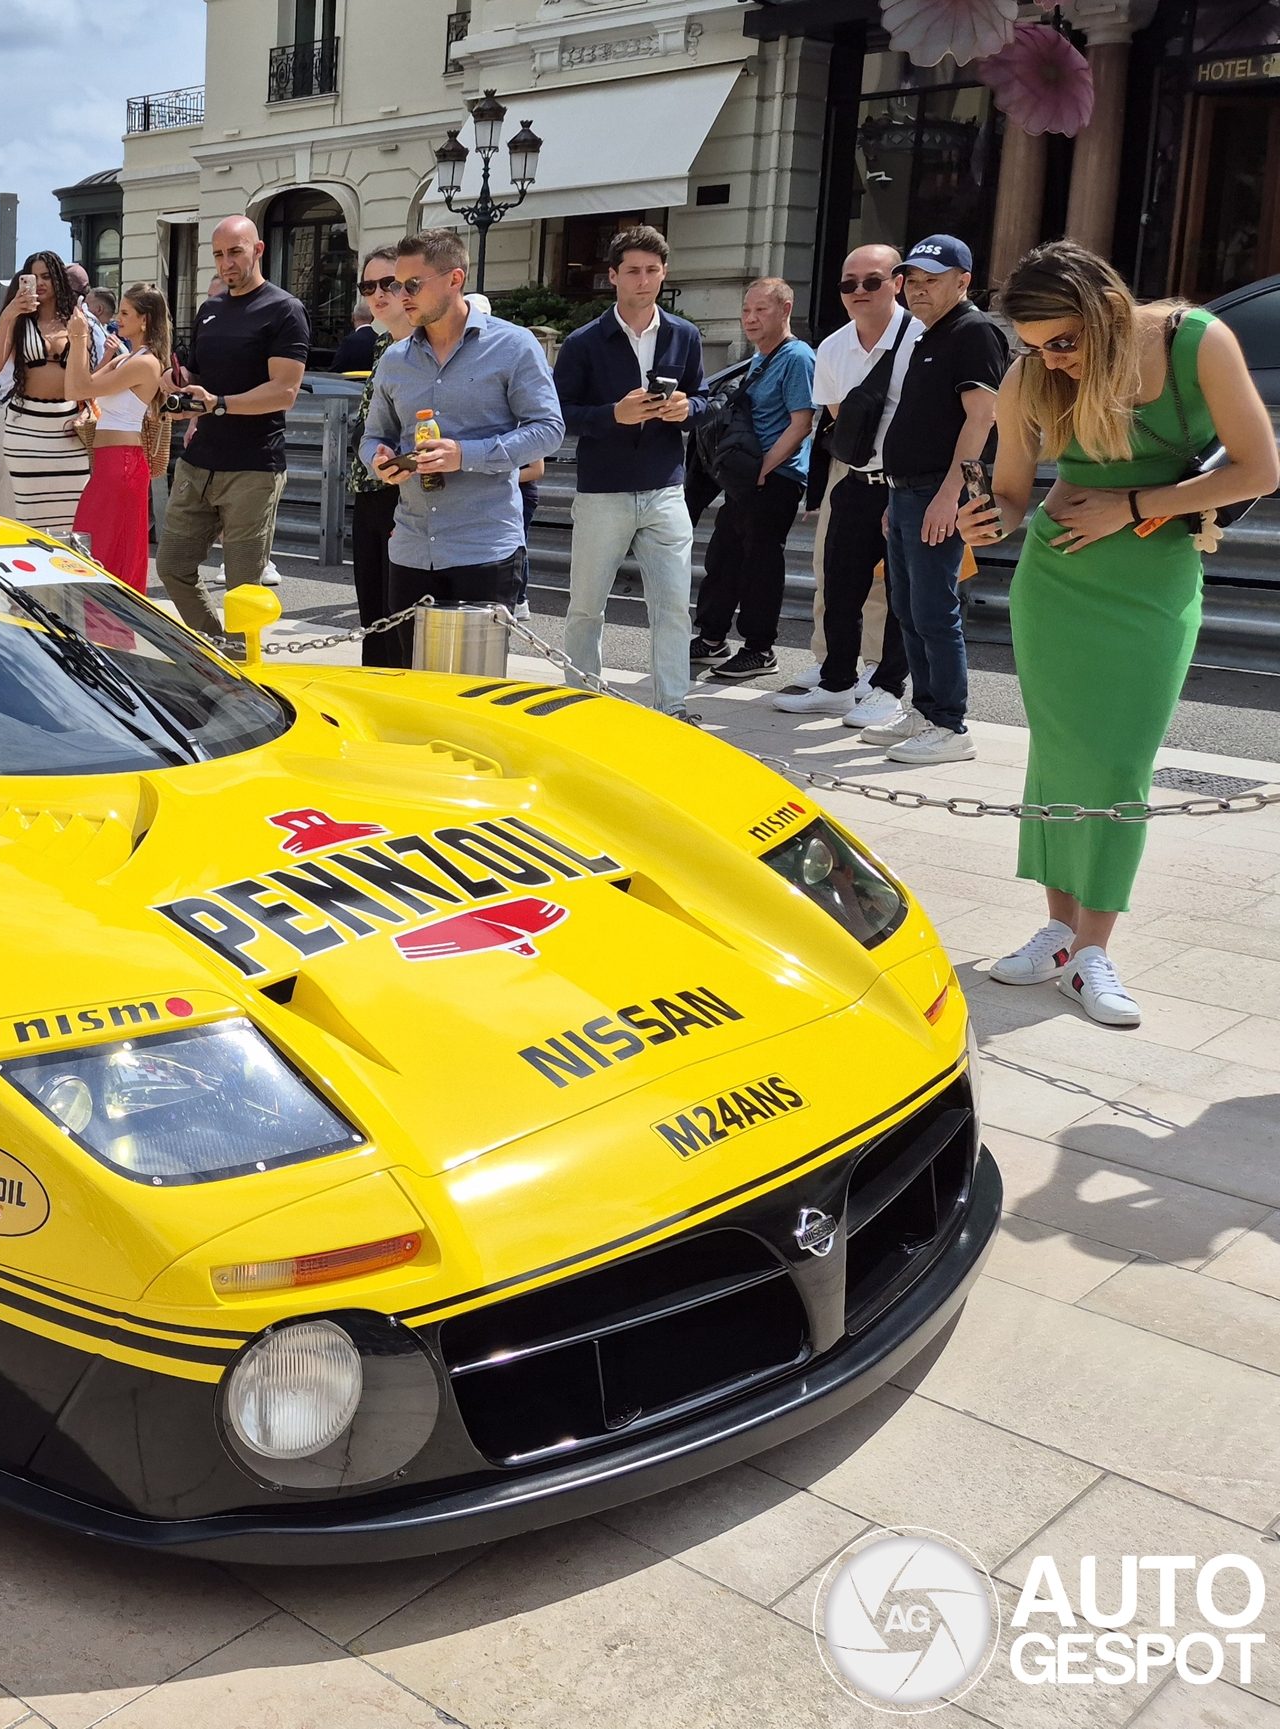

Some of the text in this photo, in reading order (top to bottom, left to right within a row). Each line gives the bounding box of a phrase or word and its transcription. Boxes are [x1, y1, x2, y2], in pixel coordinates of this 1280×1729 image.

[1198, 59, 1257, 82] HOTEL
[747, 801, 807, 842] nismo
[148, 815, 626, 980] PENNZOIL
[12, 997, 194, 1043] nismo
[517, 986, 745, 1089] NISSAN
[655, 1076, 804, 1158] M24ANS
[803, 1219, 833, 1244] NISSAN
